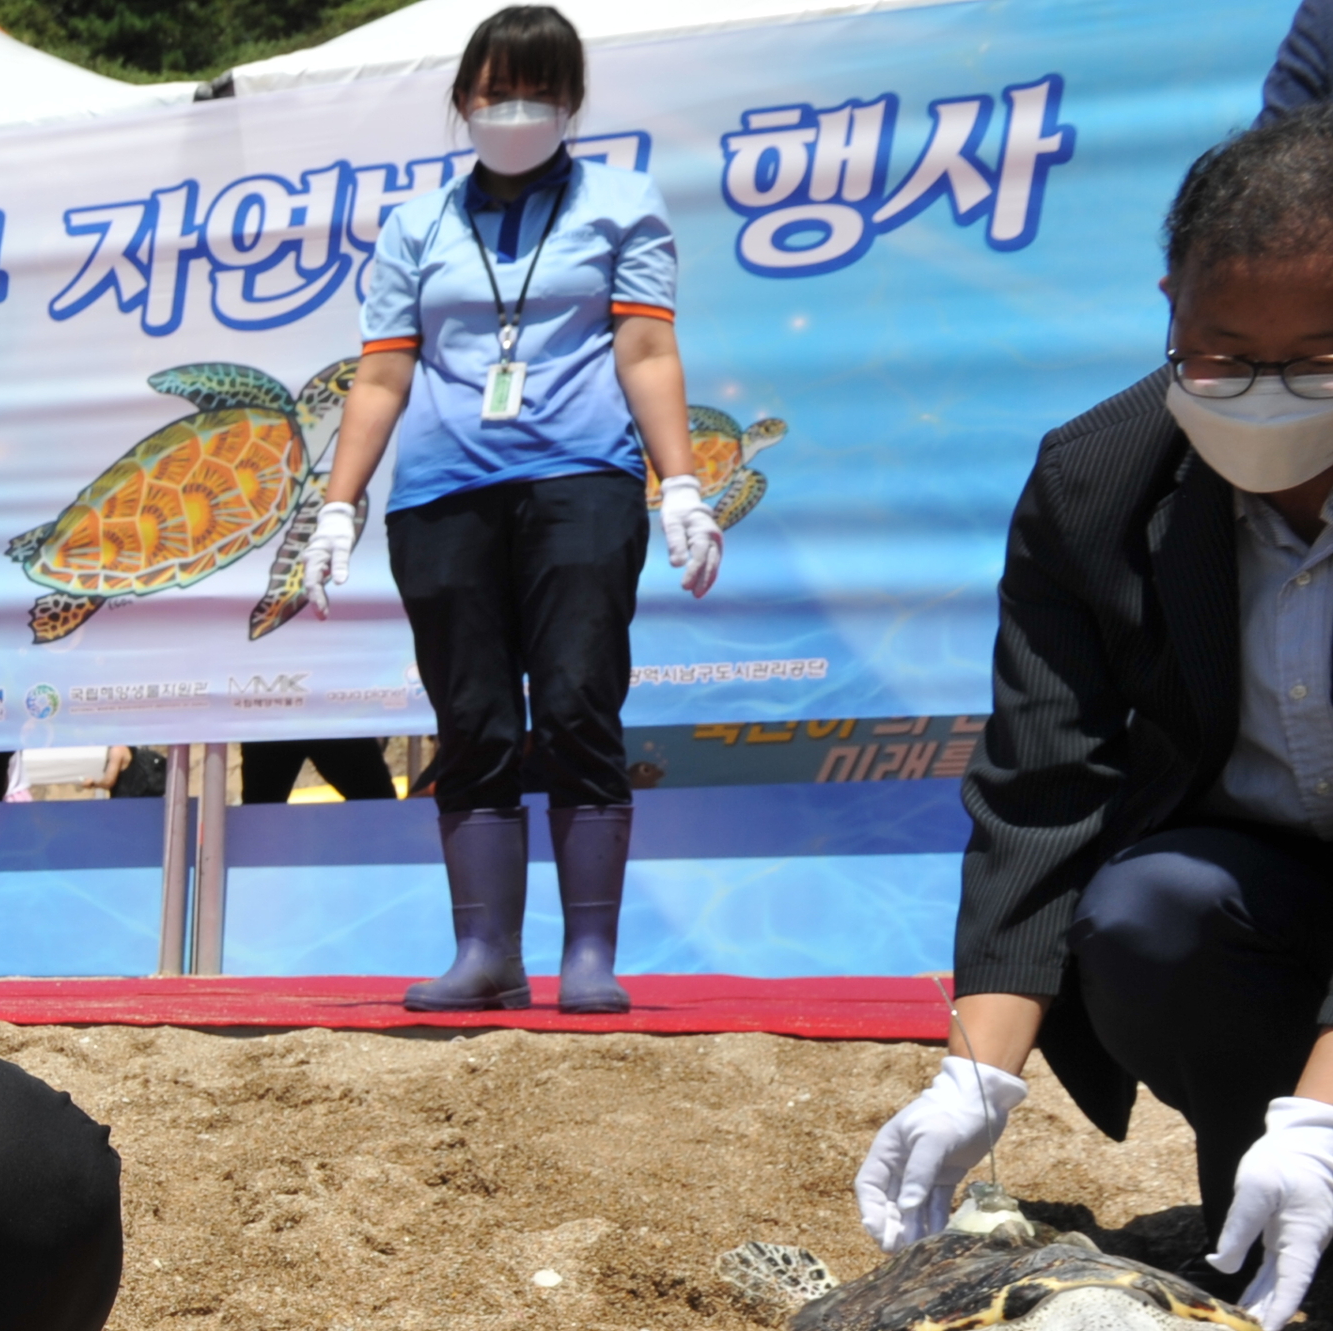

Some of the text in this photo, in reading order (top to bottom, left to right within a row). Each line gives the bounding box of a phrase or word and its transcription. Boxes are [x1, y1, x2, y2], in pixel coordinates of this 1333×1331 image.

[48, 130, 652, 336] 자연
[720, 72, 1077, 279] 행사
[228, 673, 310, 695] MMK
